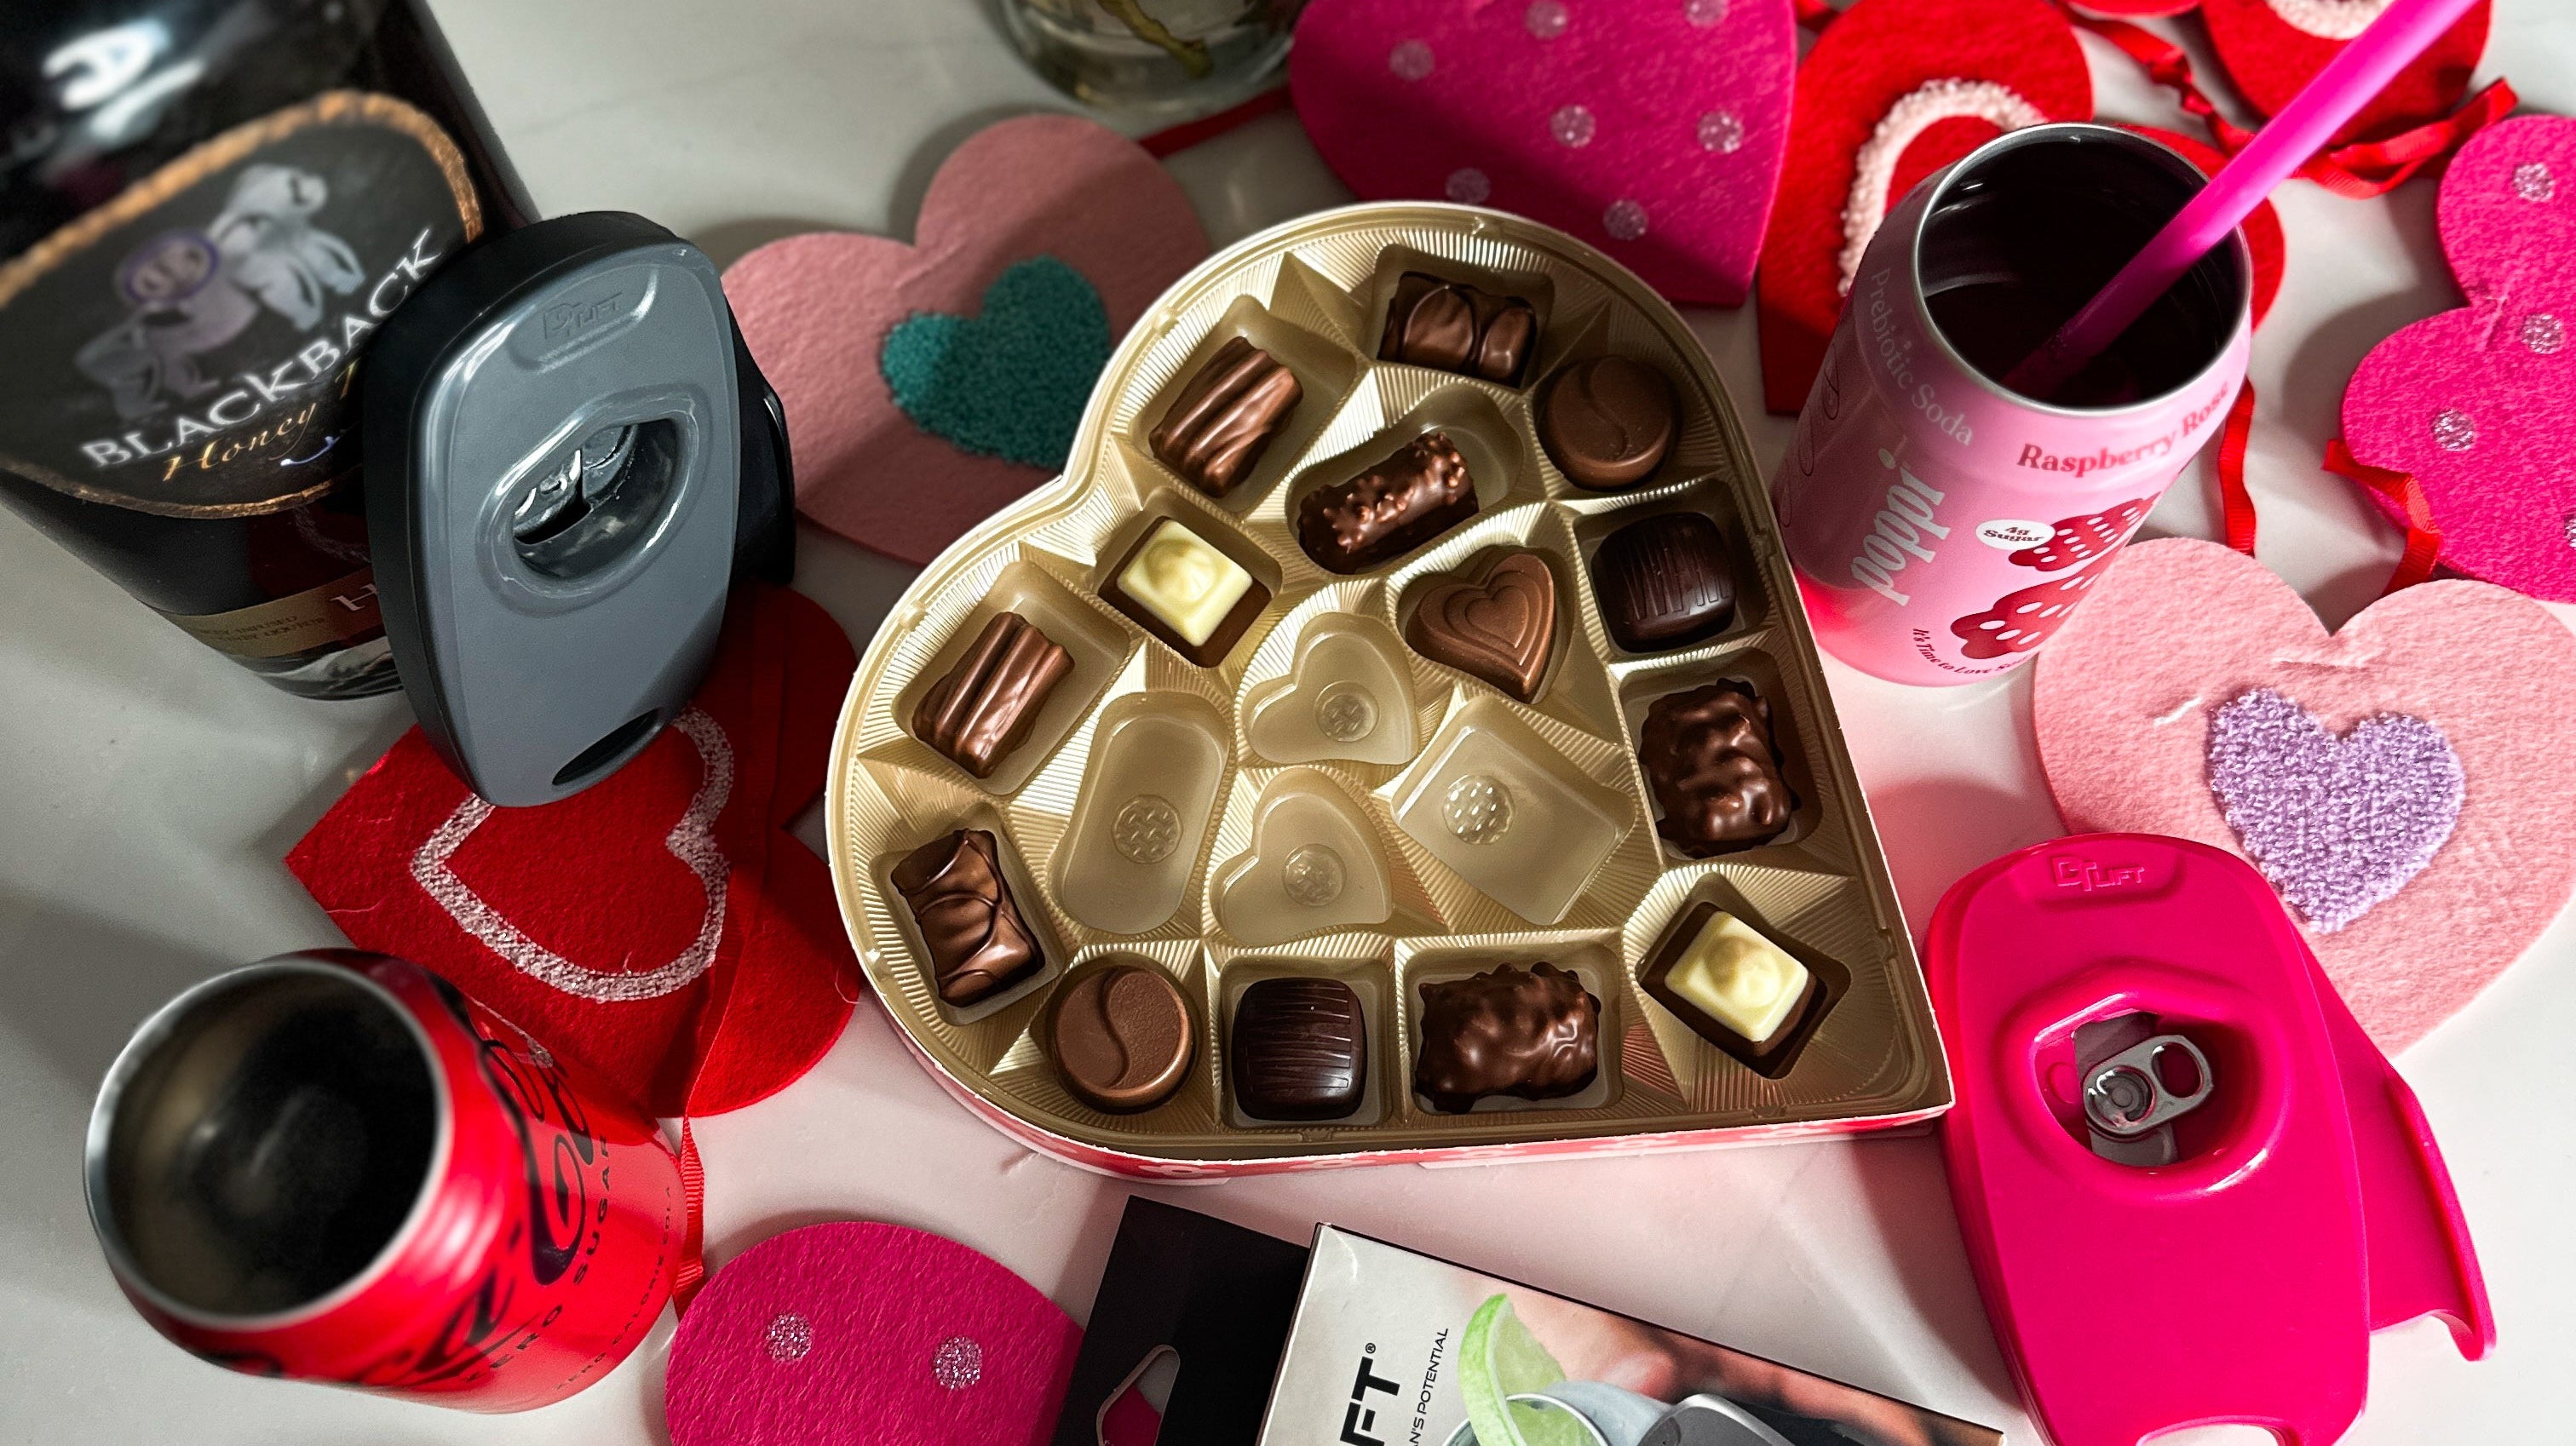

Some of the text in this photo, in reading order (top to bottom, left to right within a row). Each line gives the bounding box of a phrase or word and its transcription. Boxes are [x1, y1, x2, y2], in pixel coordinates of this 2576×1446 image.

[83, 228, 441, 468] BLACKBACK
[1871, 268, 1974, 445] Prebiotic Soda
[163, 402, 316, 482] Honey
[2016, 381, 2228, 478] Raspberry Rose
[1851, 448, 1951, 606] poppi
[1983, 529, 2044, 542] Sugar
[2004, 526, 2029, 537] 4g
[1912, 628, 1931, 643] It's
[1916, 643, 1941, 663] Time
[1937, 661, 1954, 670] to
[1954, 666, 1992, 674] Love
[466, 1133, 609, 1383] ZERO SUGAR
[1417, 1328, 1448, 1414] POTENTIAL
